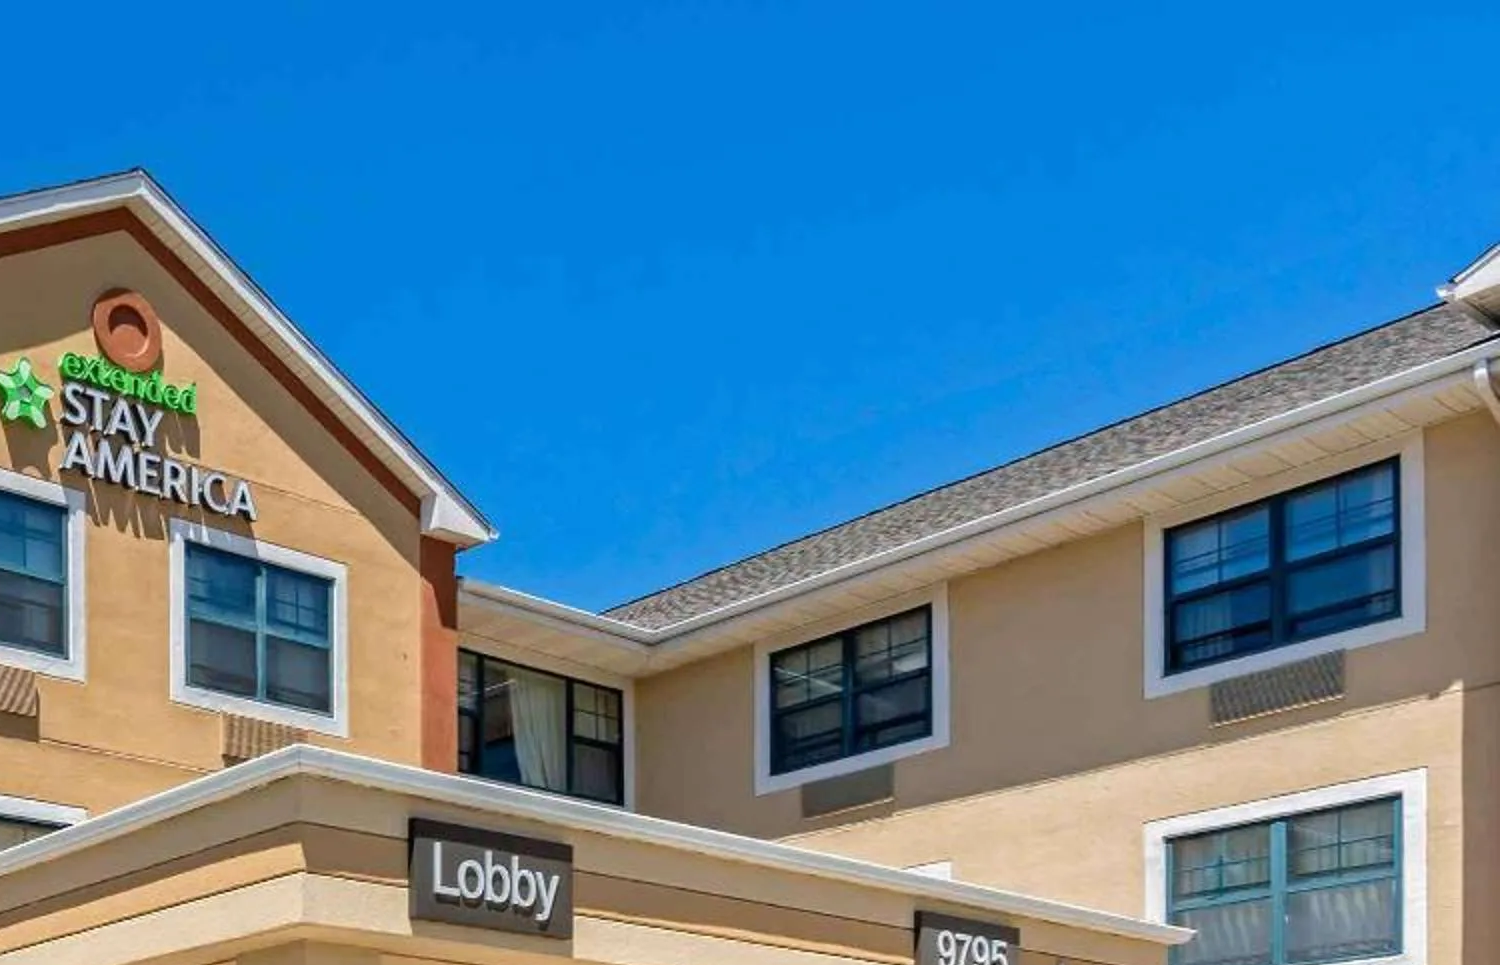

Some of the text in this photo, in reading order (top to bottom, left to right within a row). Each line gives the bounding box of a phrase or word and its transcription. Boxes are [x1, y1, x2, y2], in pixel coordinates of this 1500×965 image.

[59, 352, 197, 414] extended
[61, 381, 165, 447] STAY
[60, 431, 257, 521] AMERICA
[433, 841, 560, 921] Lobby
